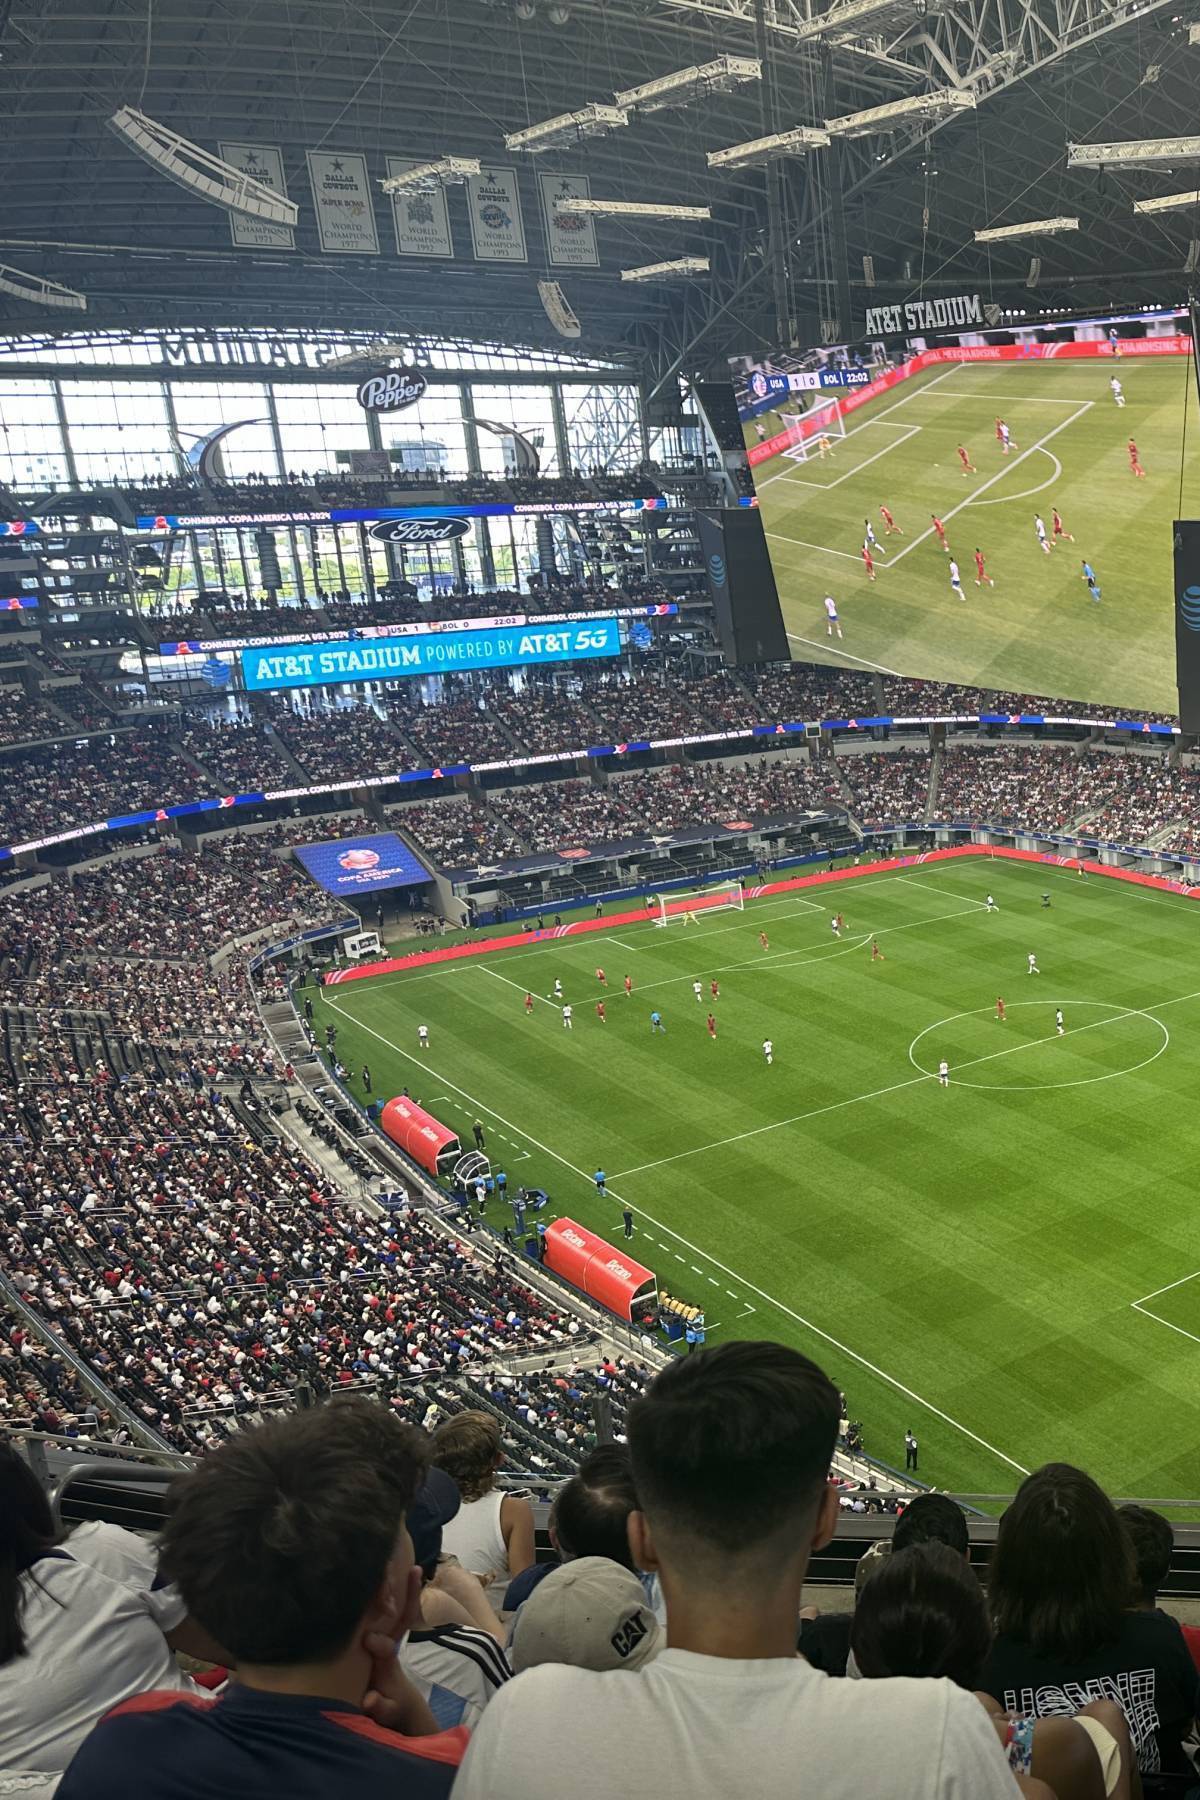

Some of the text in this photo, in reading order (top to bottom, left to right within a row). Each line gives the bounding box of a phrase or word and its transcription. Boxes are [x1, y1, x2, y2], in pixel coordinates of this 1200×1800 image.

[325, 174, 354, 183] DALLAS
[323, 182, 359, 191] COWBOYS
[479, 186, 506, 195] DALLAS
[477, 194, 510, 203] COWBOYS
[324, 230, 373, 241] CHAMPIONS
[408, 226, 438, 236] WORLD
[484, 232, 513, 241] WORLD
[401, 235, 448, 245] CHAMPIONS
[477, 240, 522, 249] CHAMPIONS
[560, 239, 586, 247] WORLD
[552, 246, 595, 255] CHAMPIONS
[865, 294, 983, 335] AT&T STADIUM
[1097, 340, 1178, 354] MECHANDISING
[770, 379, 785, 389] USA
[823, 375, 839, 385] BOL
[846, 372, 869, 383] 22:02
[367, 376, 424, 409] Pepper
[177, 515, 228, 525] CONMEBOL
[252, 513, 292, 523] AMERICA
[293, 512, 310, 522] USA
[310, 511, 332, 521] 2024
[390, 520, 450, 540] Ford
[391, 627, 408, 635] USA
[442, 622, 459, 630] BOL
[463, 621, 470, 629] 0
[494, 617, 517, 626] 22:02
[199, 631, 350, 651] CONMEBOL COPA AMERICA USA 2024
[256, 629, 608, 680] AT&T STADIUM POWERED BY AT&T 5G
[338, 873, 362, 883] COPA
[361, 867, 404, 880] AMERICA
[611, 1609, 649, 1658] CAT
